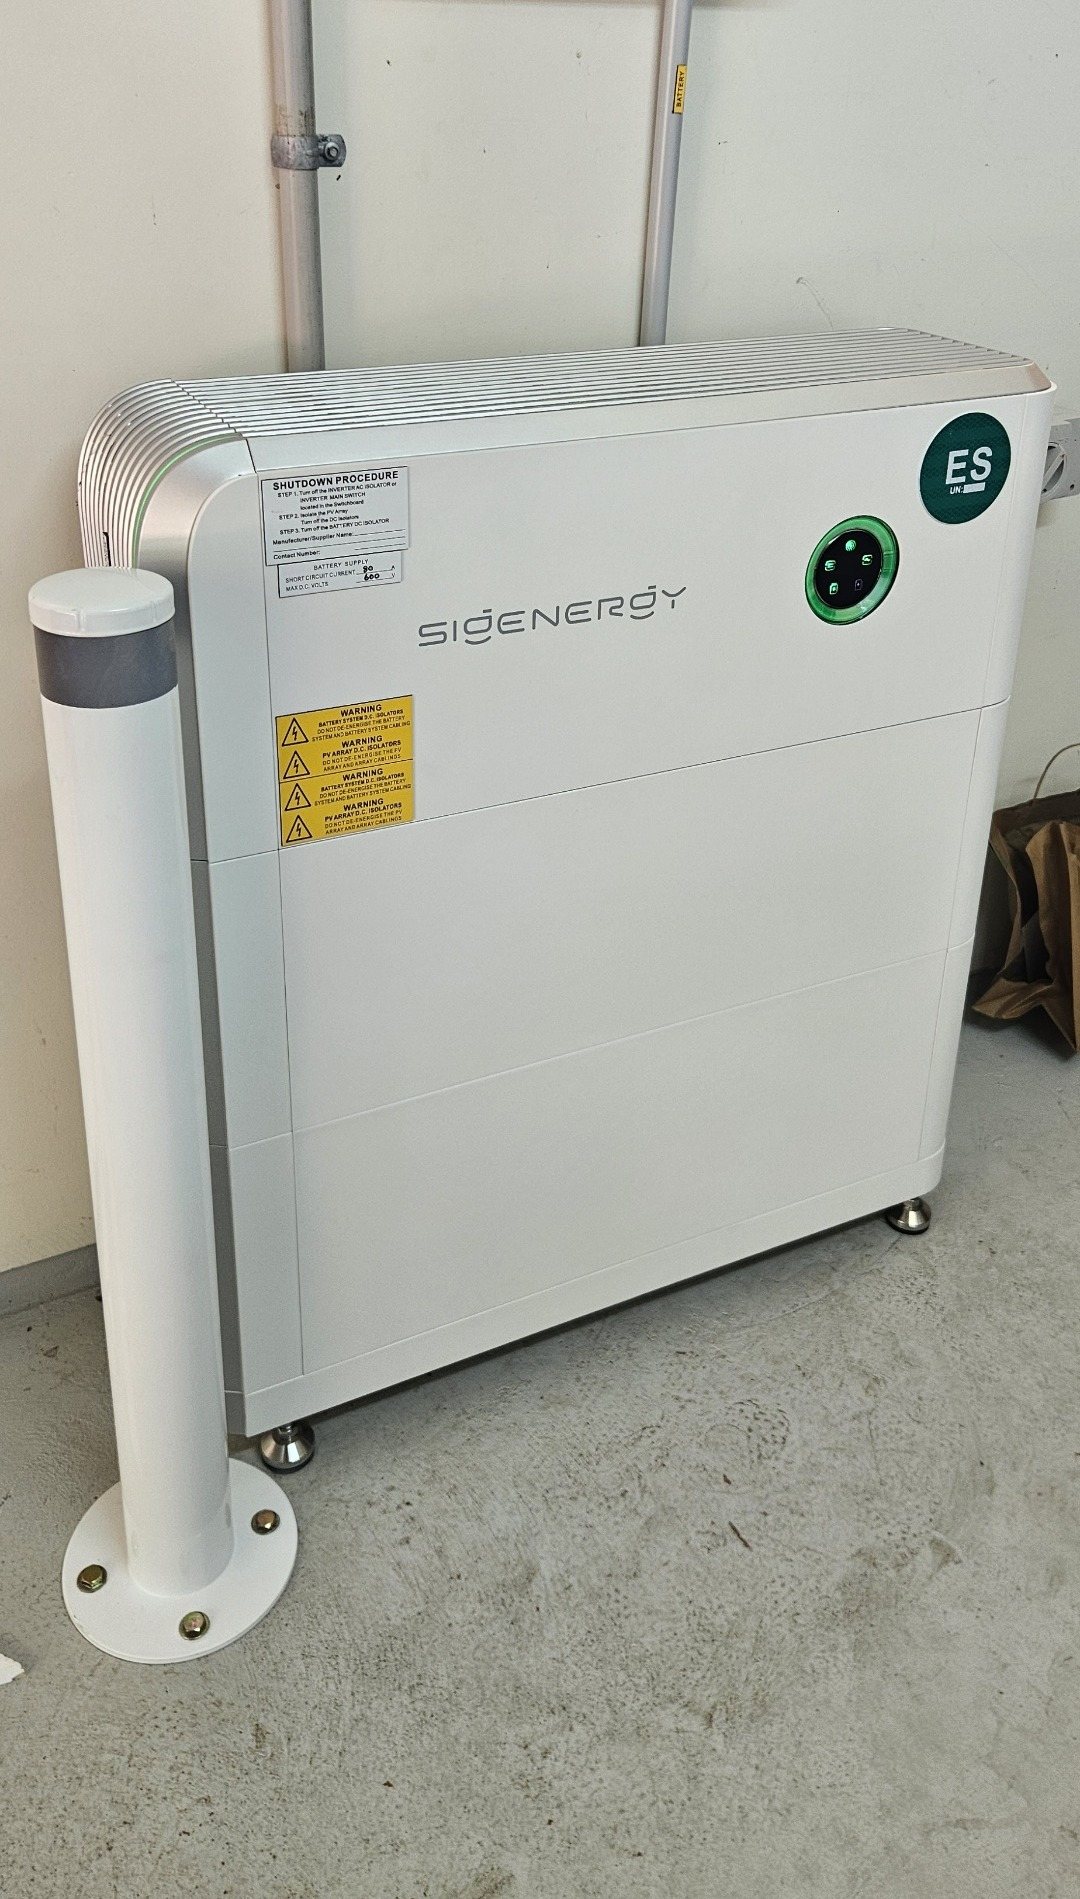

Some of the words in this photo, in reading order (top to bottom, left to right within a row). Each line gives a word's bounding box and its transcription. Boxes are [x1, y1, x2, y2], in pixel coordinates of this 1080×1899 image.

[676, 71, 684, 107] BATTERY
[945, 446, 992, 484] ES
[273, 477, 333, 490] SHUTDOWN
[336, 471, 398, 484] PROCEDURE
[330, 522, 353, 530] BATTERY
[363, 518, 389, 526] ISOLATOR
[273, 532, 335, 546] Manufacturer/Supplier
[274, 552, 297, 560] Contact
[298, 550, 320, 558] Number:
[345, 559, 368, 567] SUPPLY
[330, 570, 355, 578] CURRENT
[341, 704, 382, 717] WARNING
[343, 716, 363, 724] SYSTEM
[376, 709, 403, 718] ISOLATORS
[332, 748, 353, 756] ARRAY
[368, 740, 401, 750] ISOLATORS
[341, 735, 382, 748] WARNING
[343, 768, 383, 781] WARNING
[345, 779, 364, 787] SYSTEM
[376, 773, 404, 782] ISOLATORS
[384, 779, 406, 787] BATTERY
[347, 793, 368, 801] BATTERY
[390, 784, 411, 792] CABLING
[343, 798, 383, 811] WARNING
[334, 812, 355, 820] ARRAY
[369, 803, 402, 813] ISOLATORS
